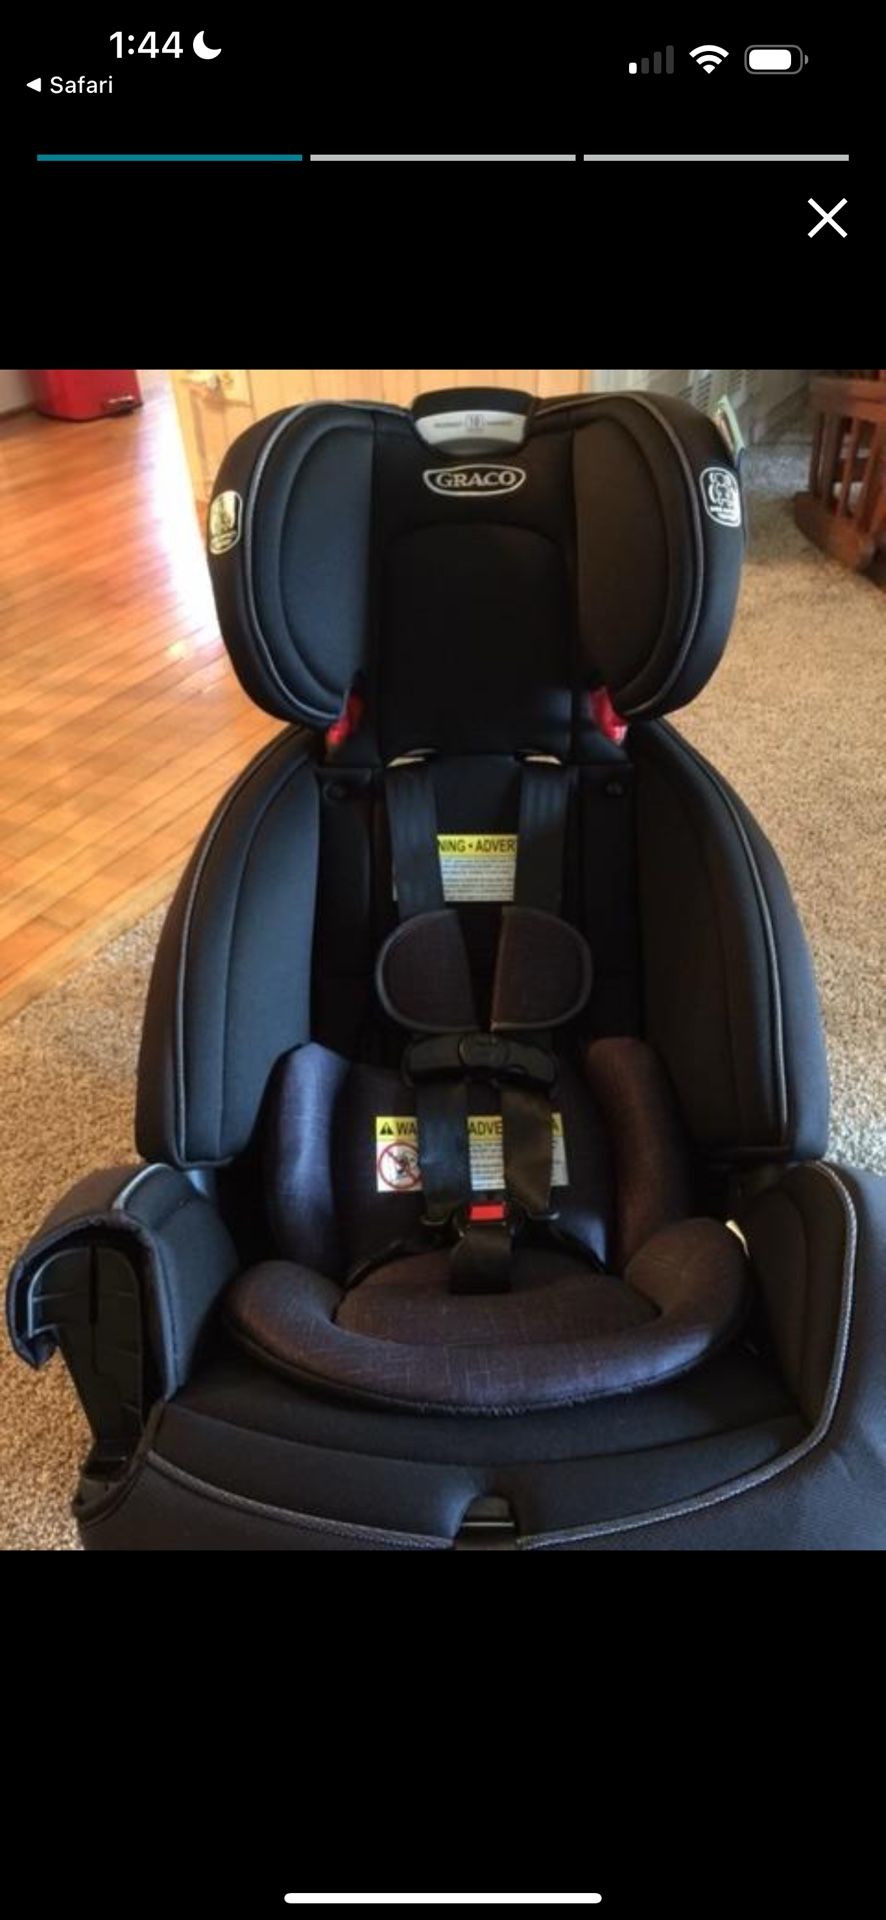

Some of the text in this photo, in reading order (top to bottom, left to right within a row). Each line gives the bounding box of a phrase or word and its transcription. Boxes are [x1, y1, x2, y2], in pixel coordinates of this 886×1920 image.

[109, 31, 184, 59] 1:44
[50, 75, 113, 94] Safari
[436, 470, 516, 488] GRACO
